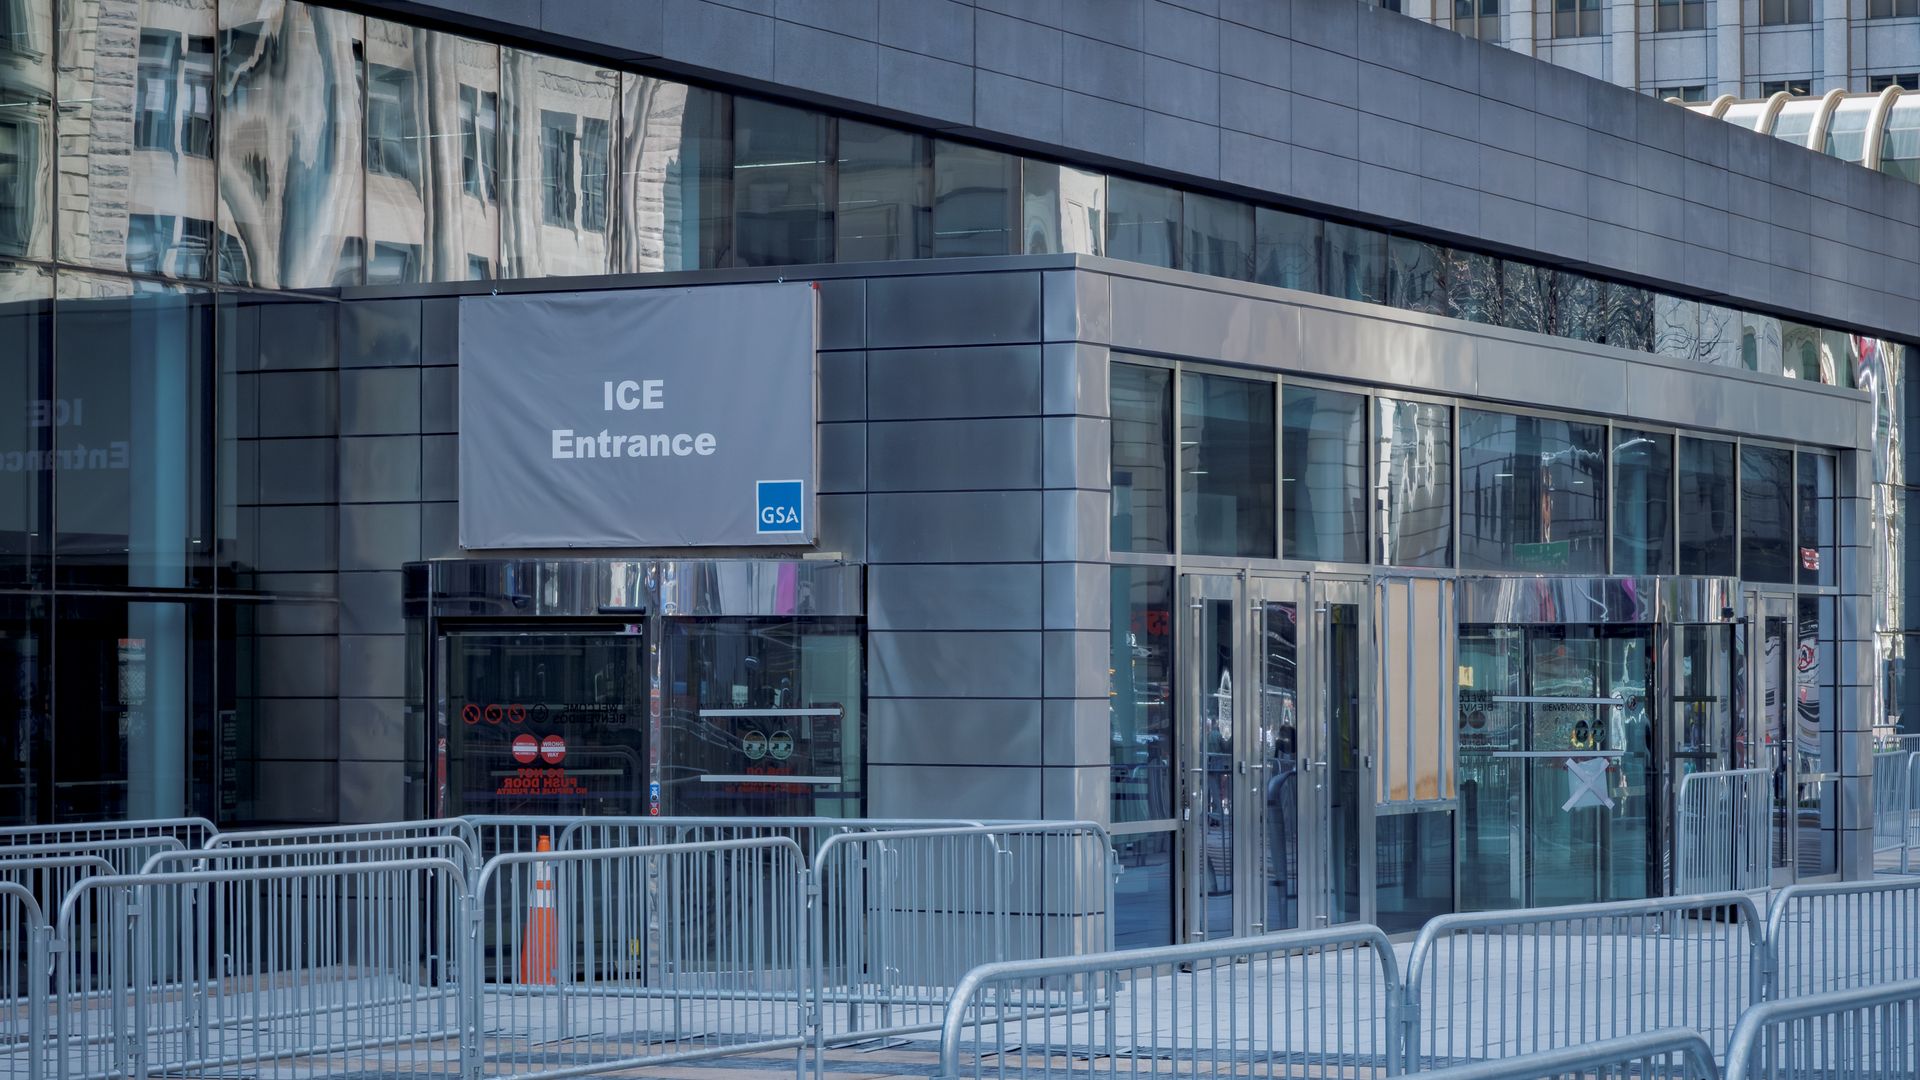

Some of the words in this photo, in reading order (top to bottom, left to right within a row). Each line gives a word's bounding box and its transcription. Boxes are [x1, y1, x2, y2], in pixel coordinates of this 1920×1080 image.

[604, 379, 664, 411] ICE
[551, 429, 717, 459] Entrance
[761, 506, 799, 524] GSA
